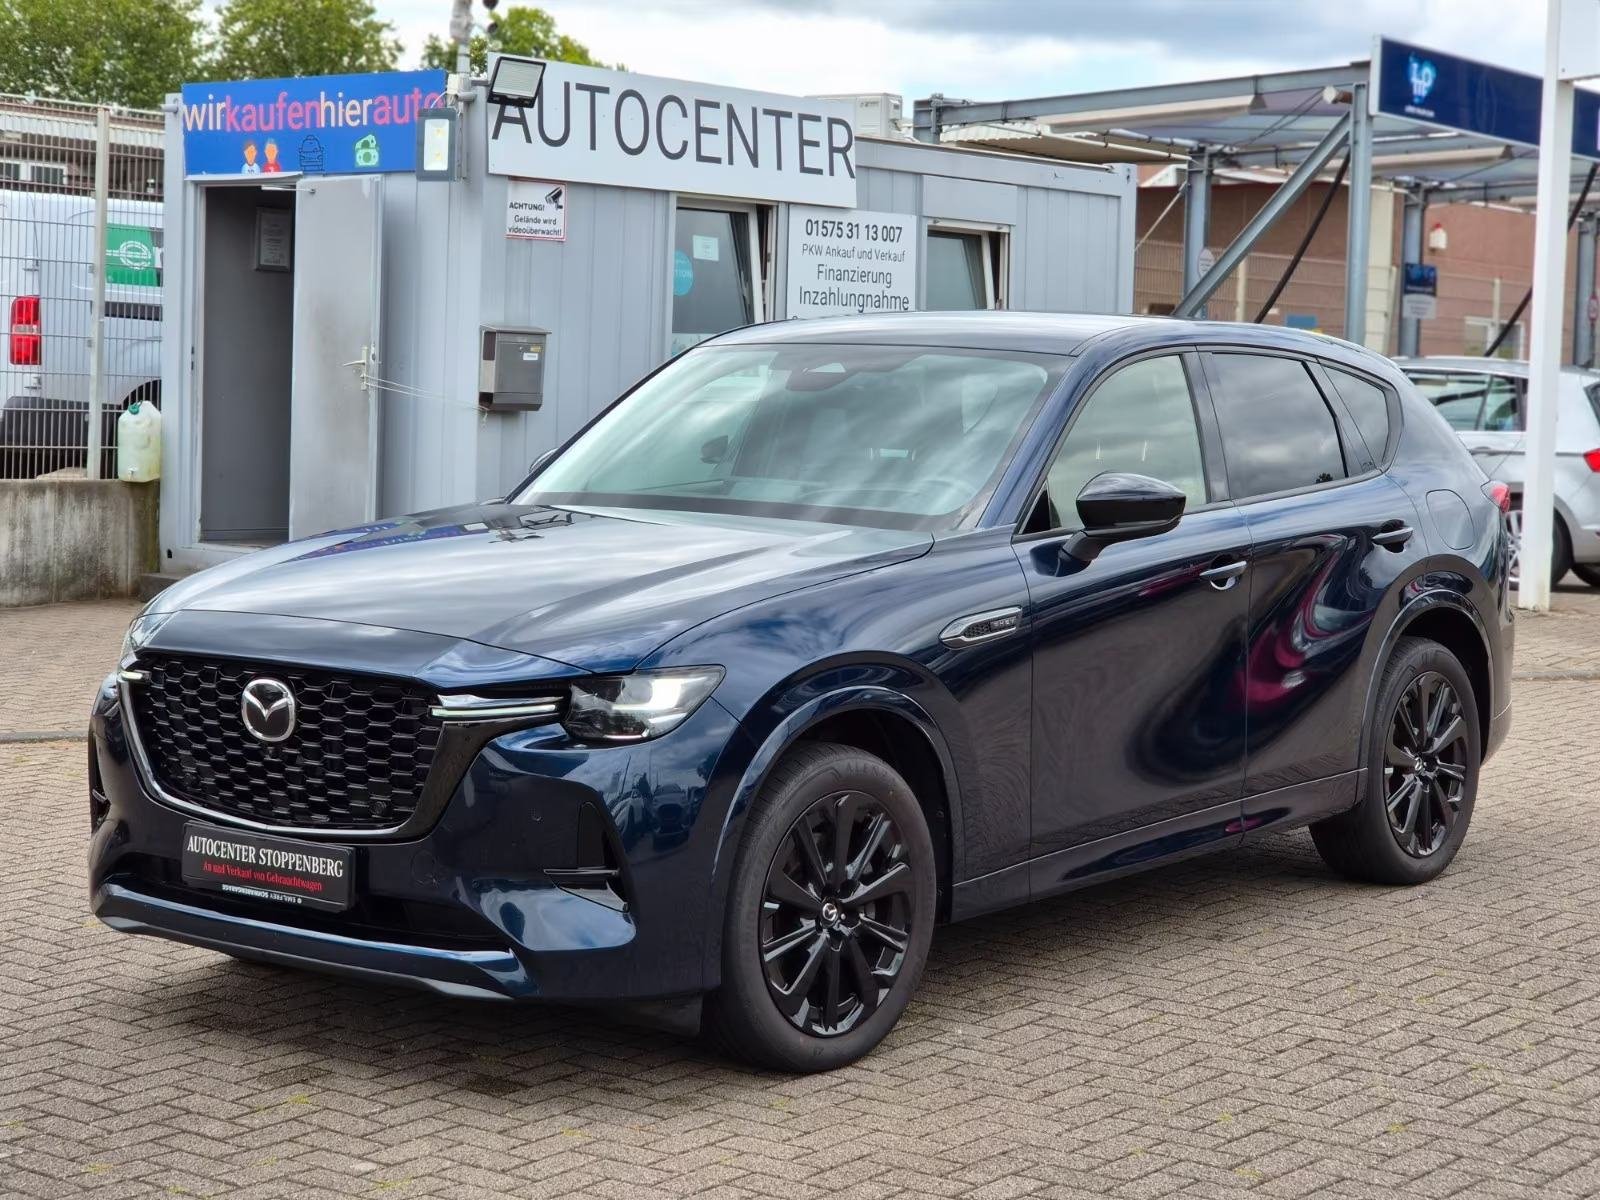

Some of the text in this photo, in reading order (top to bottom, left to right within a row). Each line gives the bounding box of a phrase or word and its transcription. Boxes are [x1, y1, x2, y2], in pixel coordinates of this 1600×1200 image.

[492, 80, 856, 179] AUTOCENTER
[509, 202, 545, 211] ACHTUNG!
[507, 226, 562, 236] videoüberwacht!
[514, 215, 542, 225] Gelände
[805, 218, 903, 243] 01575 31 13 007
[802, 243, 906, 262] PKW Ankauf und Verkauf
[817, 264, 892, 289] Finanzierung
[799, 286, 910, 313] Inzahlungnahme
[187, 834, 343, 877] AUTOCENTER STOPPENBERG
[203, 861, 212, 872] An
[213, 864, 225, 874] und
[226, 864, 252, 879] Verkauf
[254, 870, 265, 879] von
